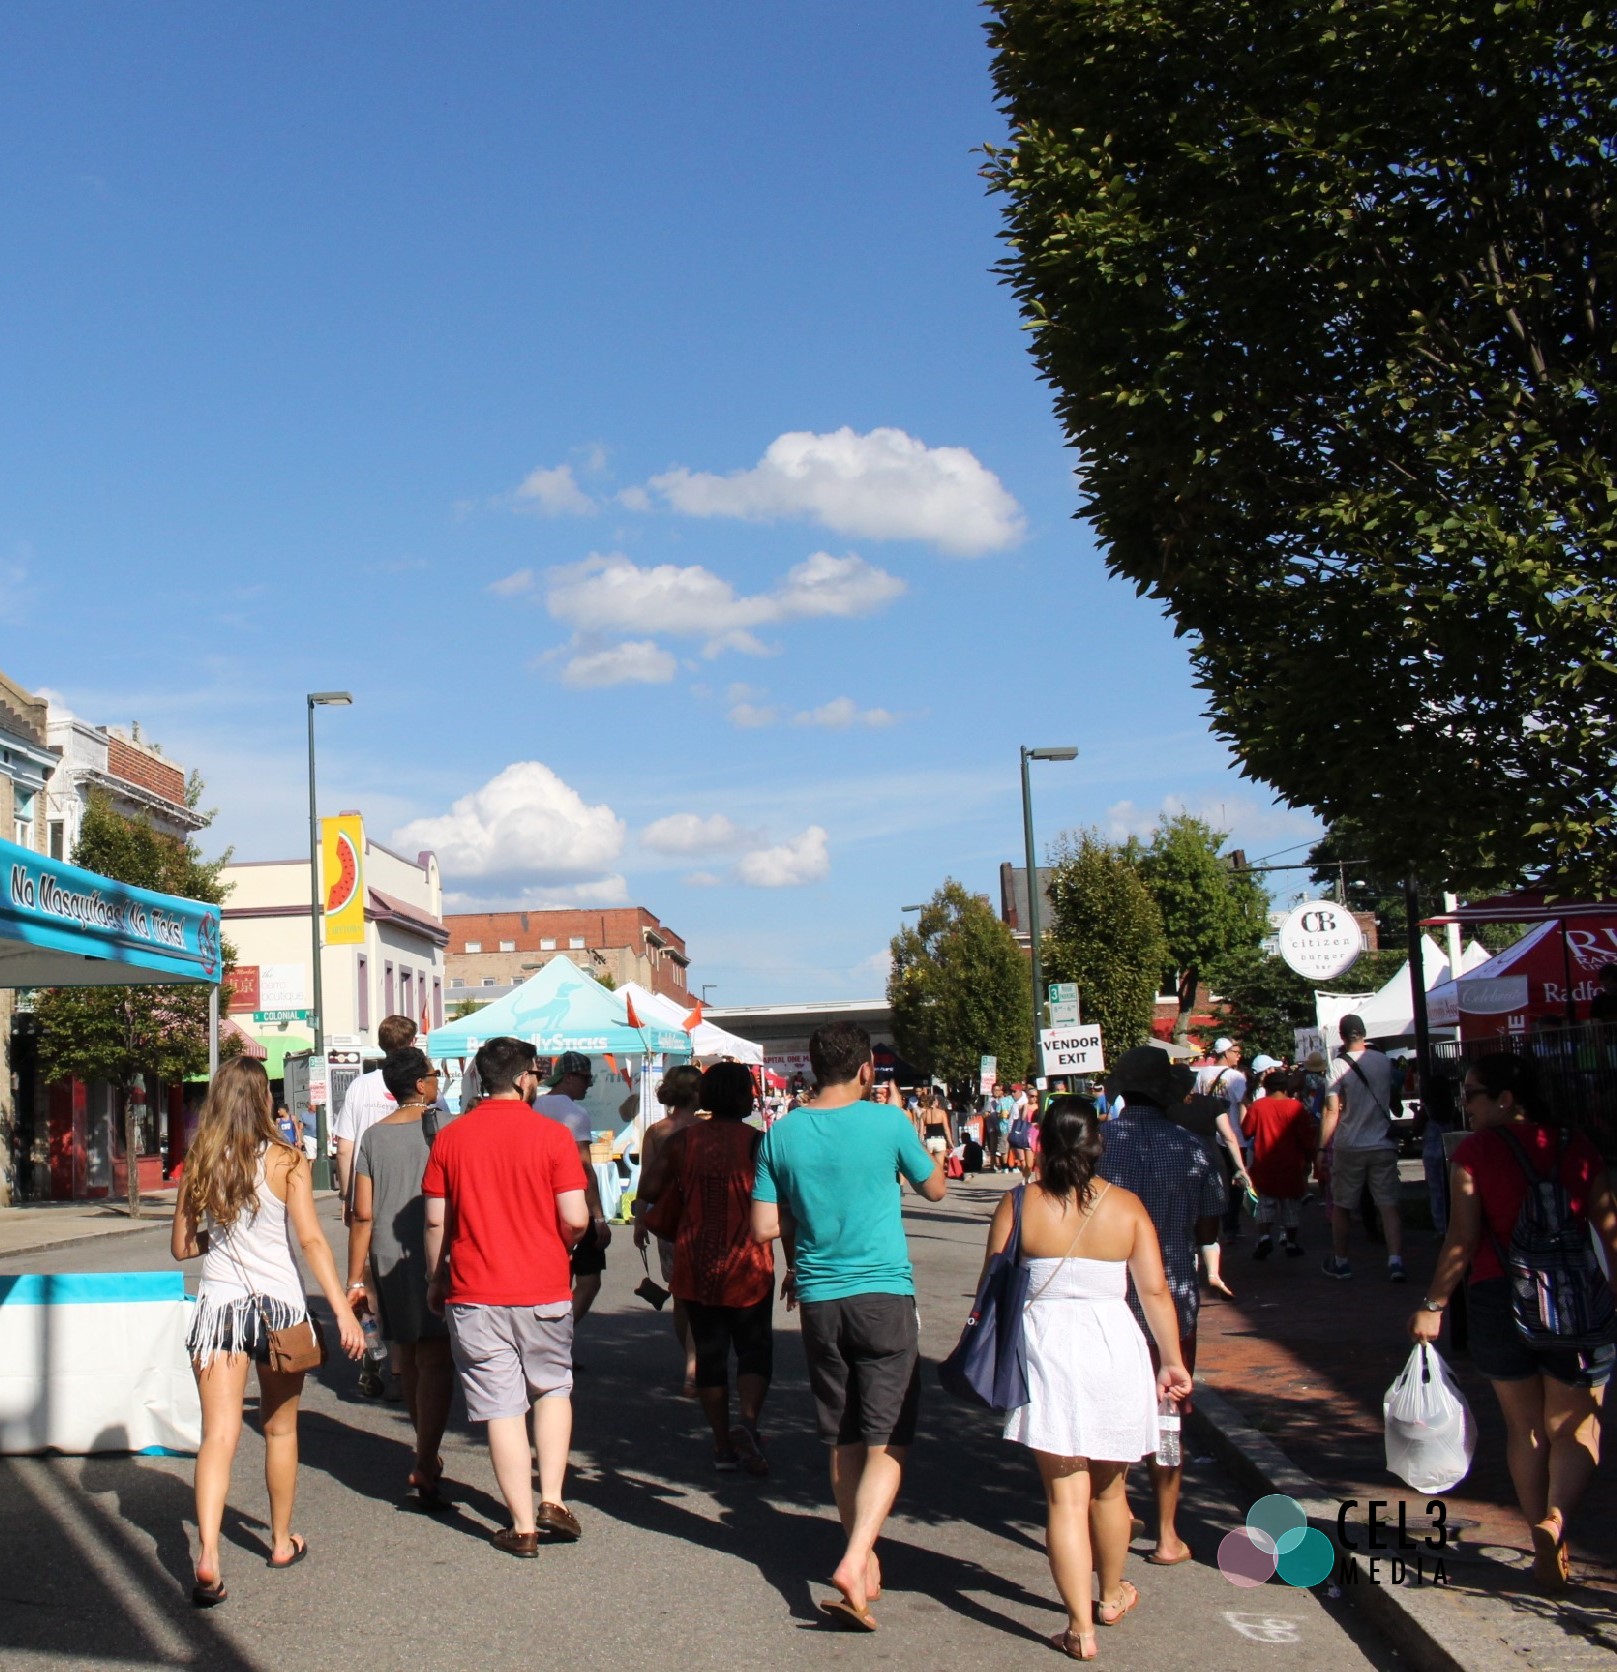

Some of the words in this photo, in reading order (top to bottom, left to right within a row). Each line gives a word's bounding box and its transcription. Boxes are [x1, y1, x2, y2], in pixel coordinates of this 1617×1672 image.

[10, 864, 35, 910] No
[39, 872, 129, 932] Mosquitoes!
[128, 904, 151, 940] No
[151, 909, 187, 949] Ticks!
[1292, 938, 1350, 948] citizen
[1051, 988, 1058, 1000] 3
[263, 1010, 300, 1021] COLONIAL
[1044, 1037, 1099, 1051] VENDOR
[787, 1055, 801, 1063] ONE
[1059, 1052, 1087, 1065] EXIT
